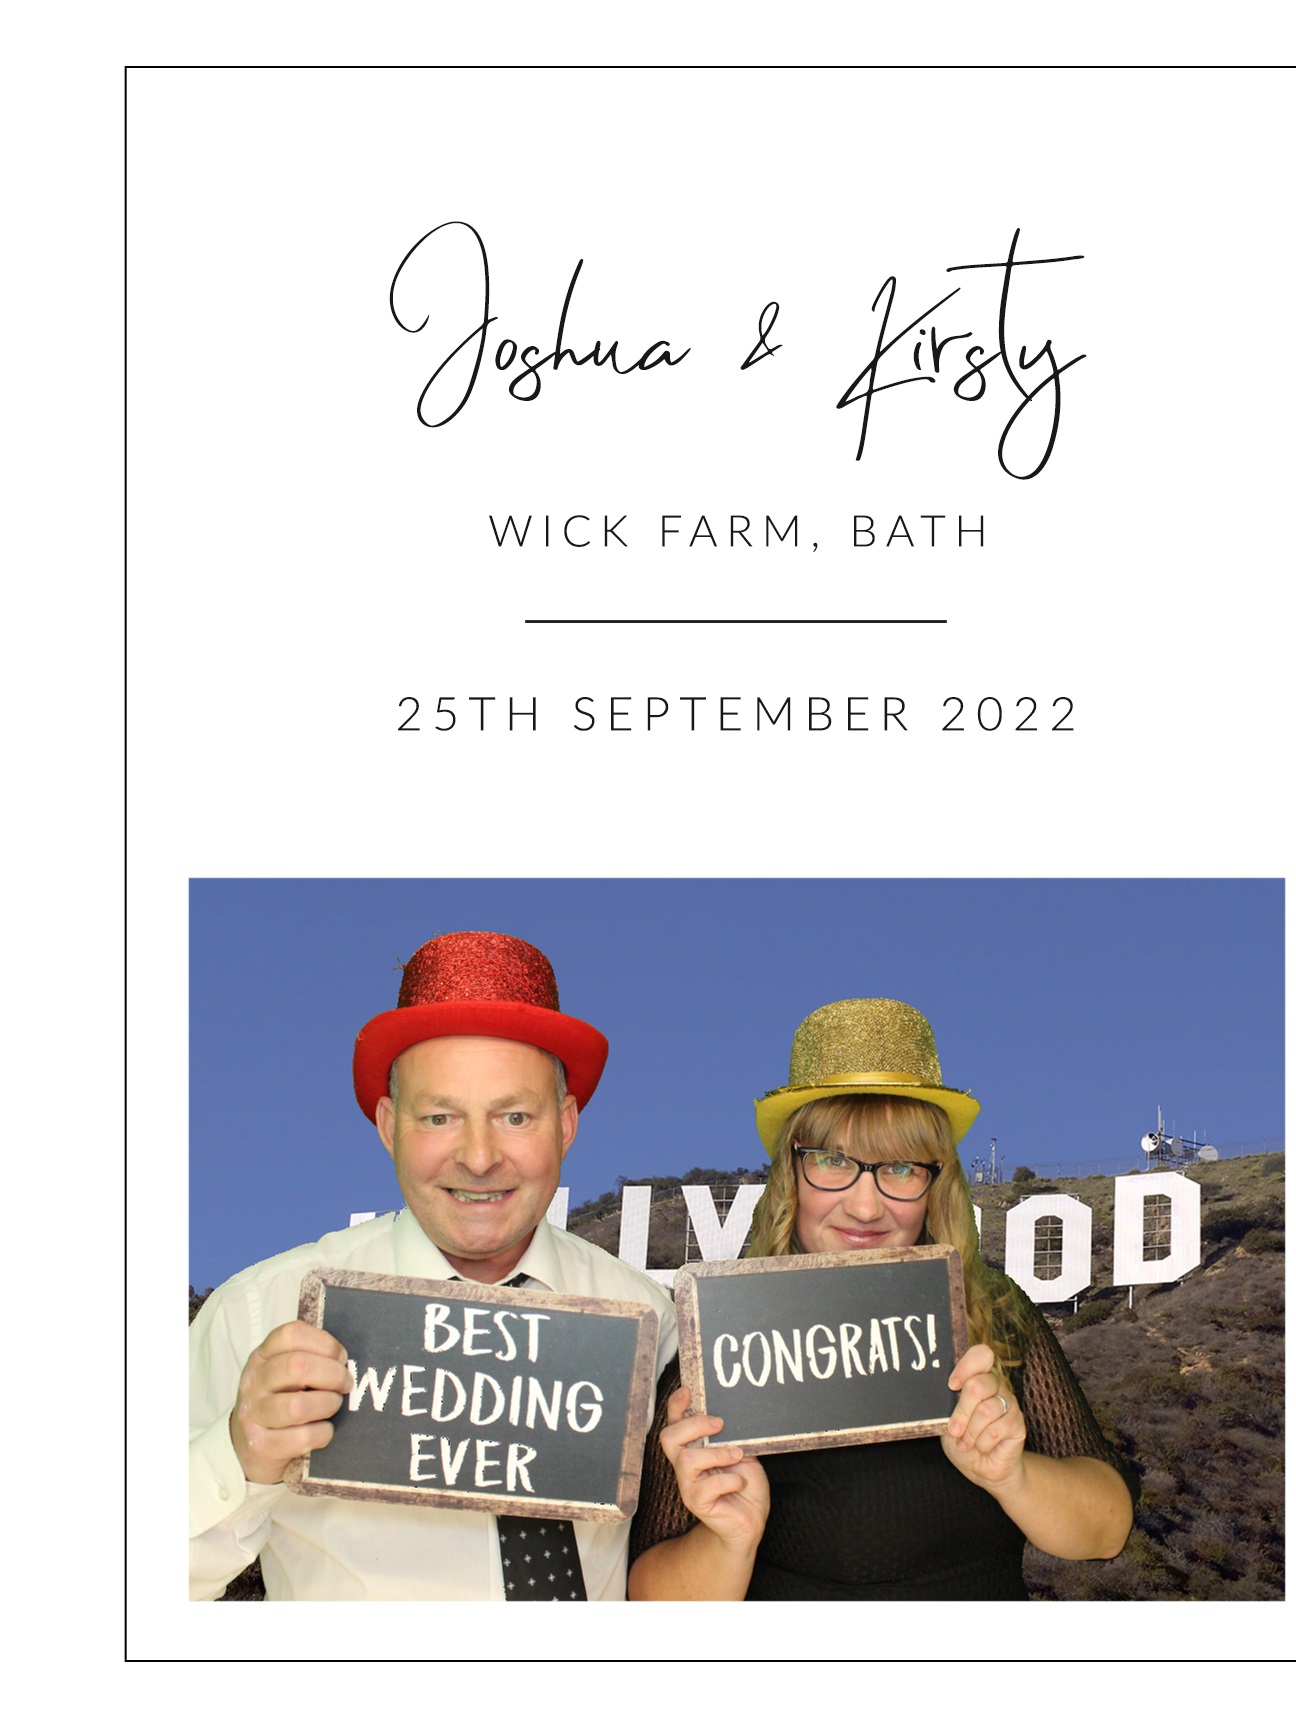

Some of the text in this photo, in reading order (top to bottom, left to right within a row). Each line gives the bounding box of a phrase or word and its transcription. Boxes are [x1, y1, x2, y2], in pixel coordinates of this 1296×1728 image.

[422, 1302, 552, 1363] BEST
[712, 1314, 941, 1388] CONGRATS!
[346, 1358, 604, 1434] WEDDING
[409, 1432, 538, 1494] EVER
